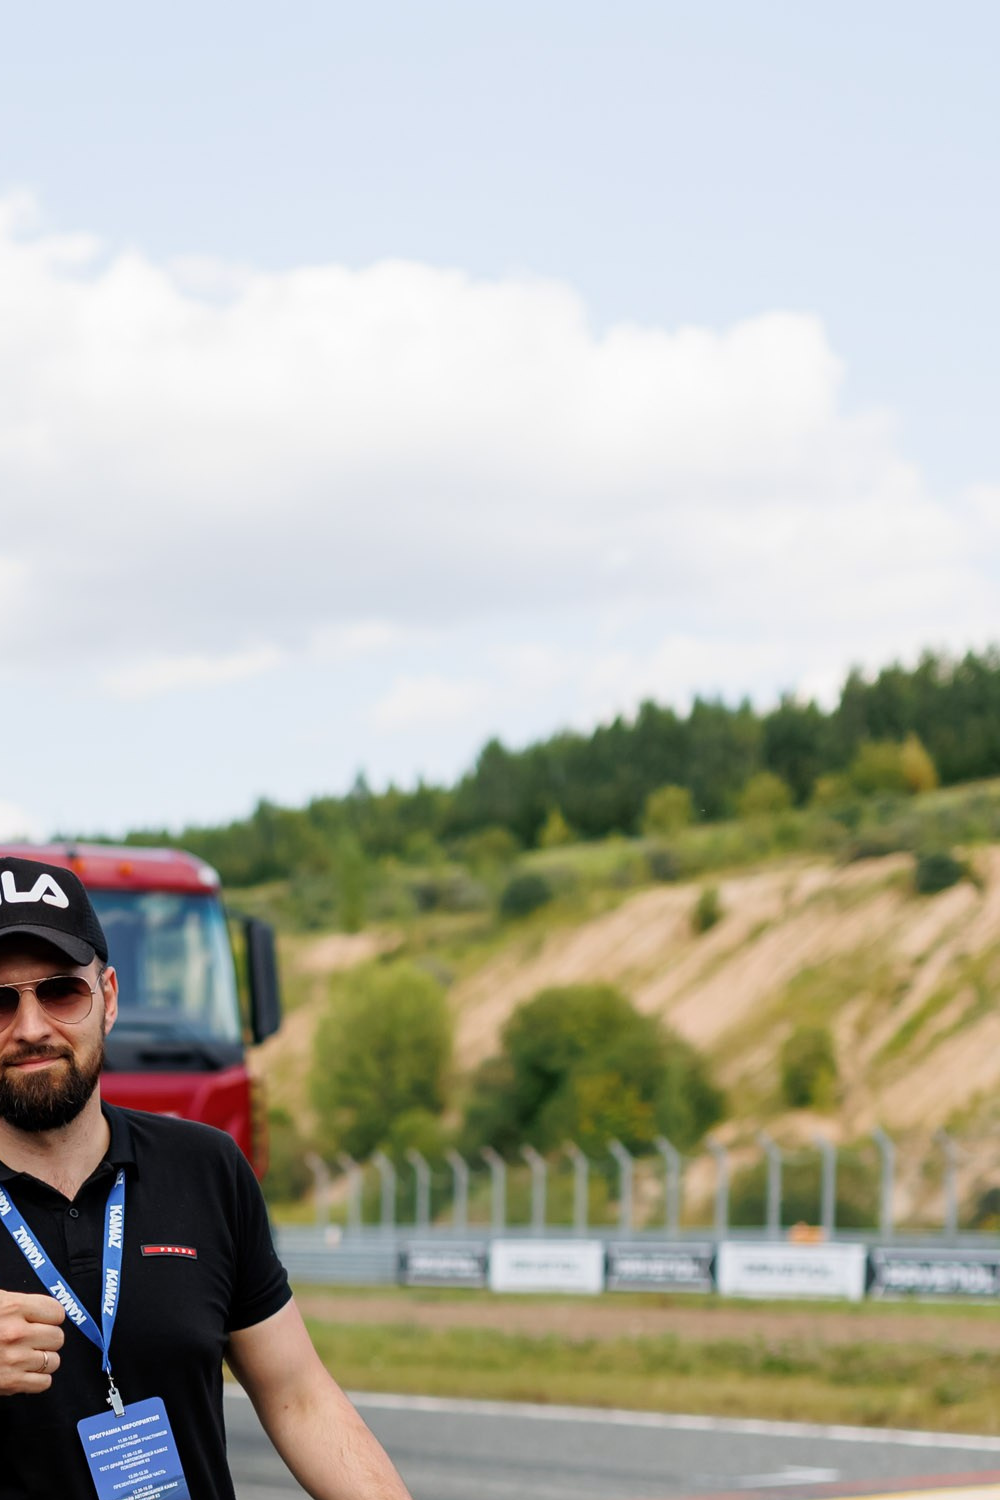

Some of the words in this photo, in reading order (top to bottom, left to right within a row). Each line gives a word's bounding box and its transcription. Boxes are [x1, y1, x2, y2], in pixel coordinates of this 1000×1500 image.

[12, 1225, 46, 1269] KAMAZ
[108, 1204, 123, 1249] KAMAZ
[49, 1280, 87, 1326] KAMAZ
[103, 1268, 119, 1317] KAMAZ
[88, 1427, 121, 1441] ПРОГРАММА
